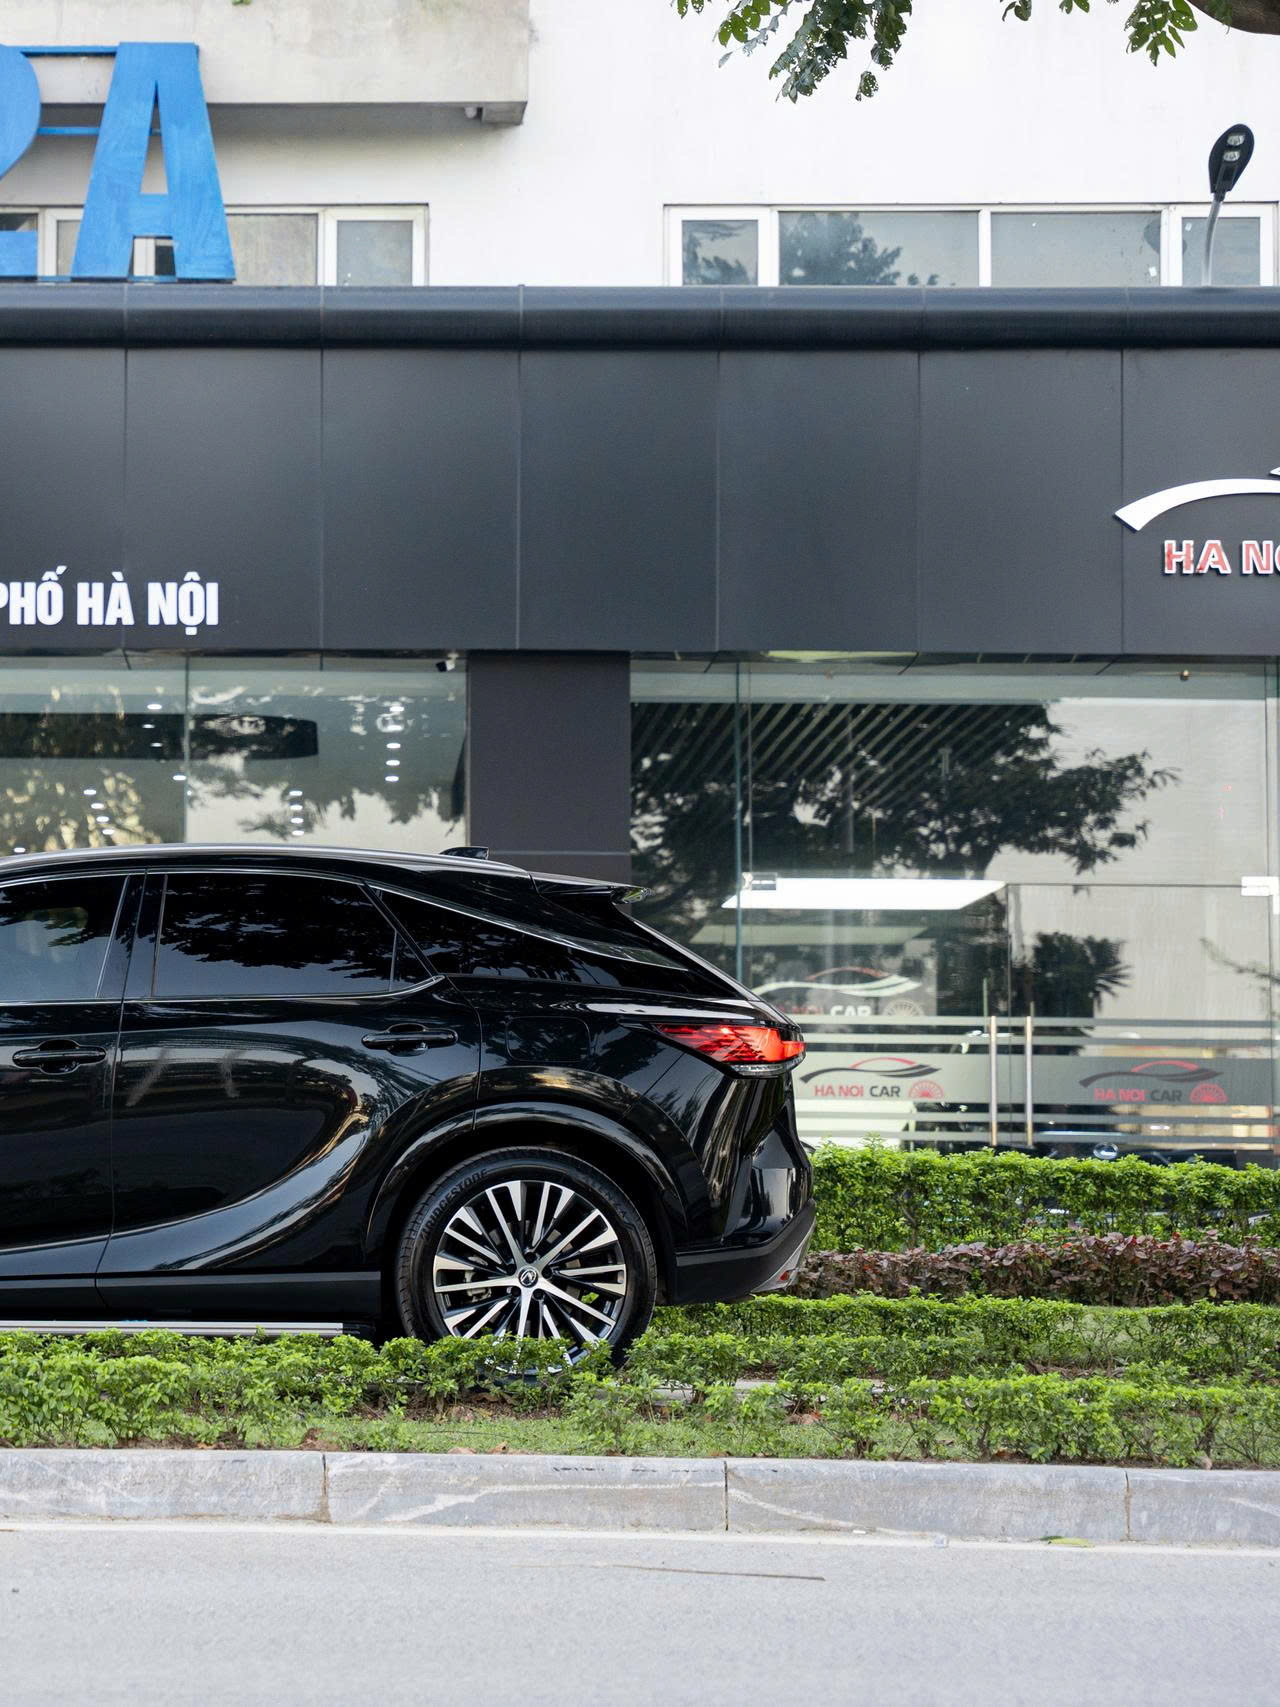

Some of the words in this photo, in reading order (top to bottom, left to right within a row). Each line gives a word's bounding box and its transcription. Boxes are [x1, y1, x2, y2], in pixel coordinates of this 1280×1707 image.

[1163, 539, 1232, 575] HA
[1241, 539, 1280, 575] N
[76, 571, 135, 626] HÀ
[147, 571, 219, 636] NỘI
[815, 1085, 834, 1097] HA
[839, 1085, 864, 1097] NOI
[870, 1085, 901, 1098] CAR
[1094, 1088, 1116, 1101] HA
[1119, 1088, 1145, 1101] NOI
[1150, 1089, 1183, 1102] CAR
